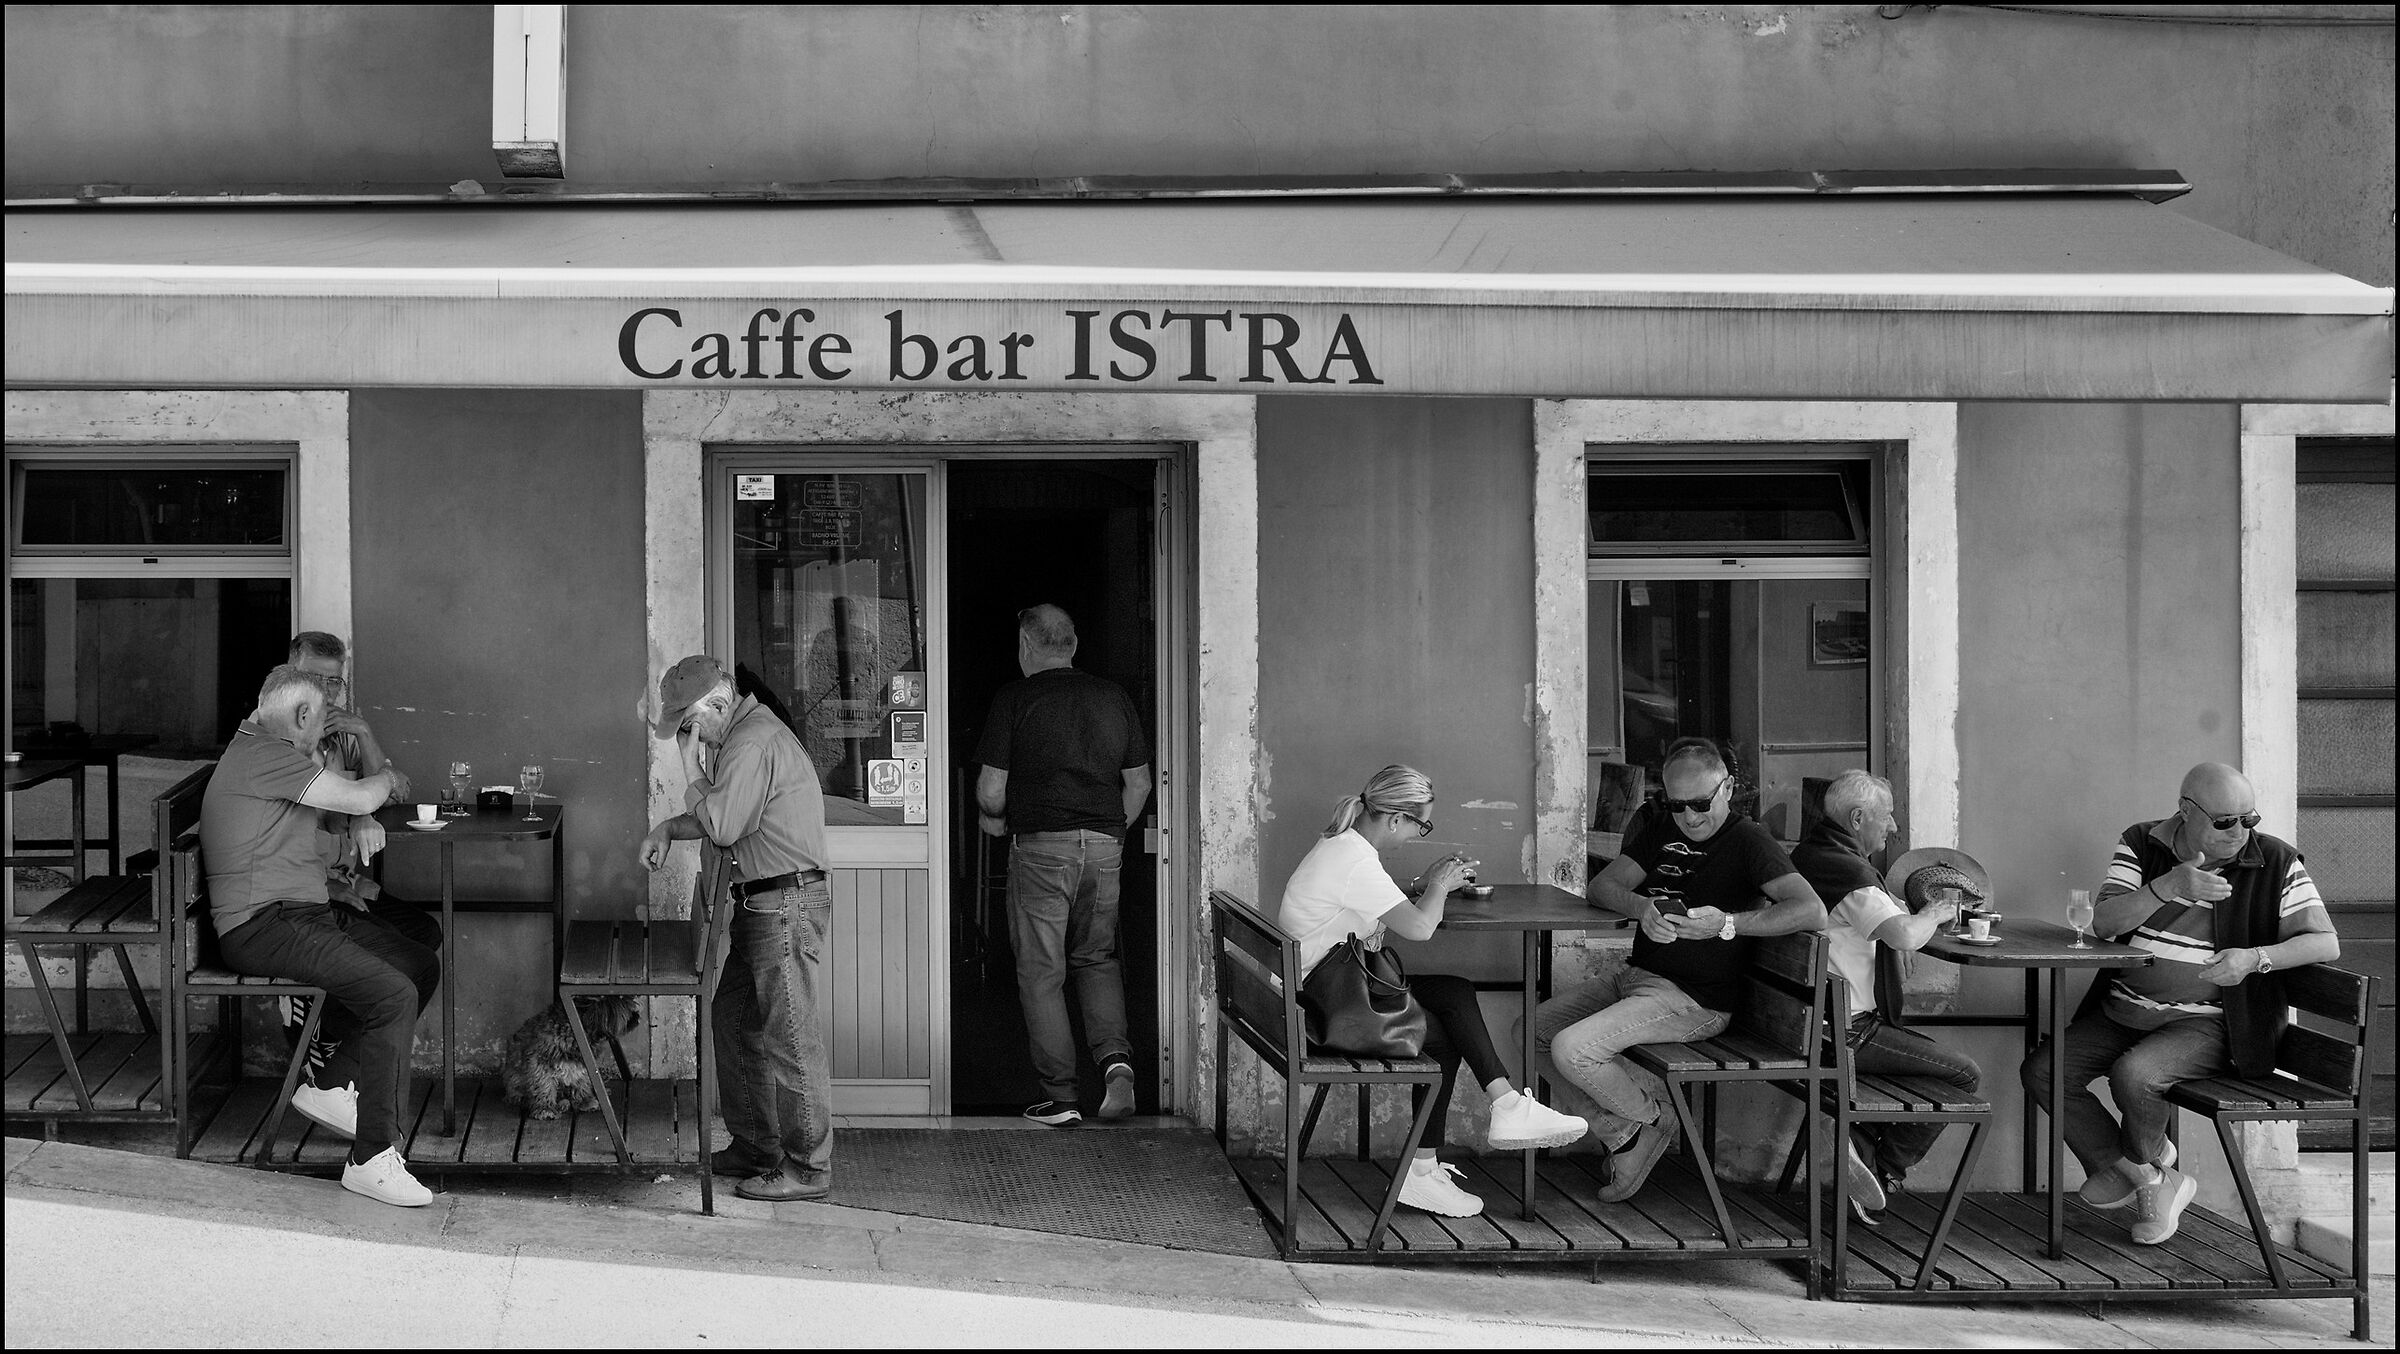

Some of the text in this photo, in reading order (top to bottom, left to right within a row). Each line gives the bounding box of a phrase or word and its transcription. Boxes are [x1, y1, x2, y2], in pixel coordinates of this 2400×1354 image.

[619, 308, 1383, 384] Caffe bar ISTRA
